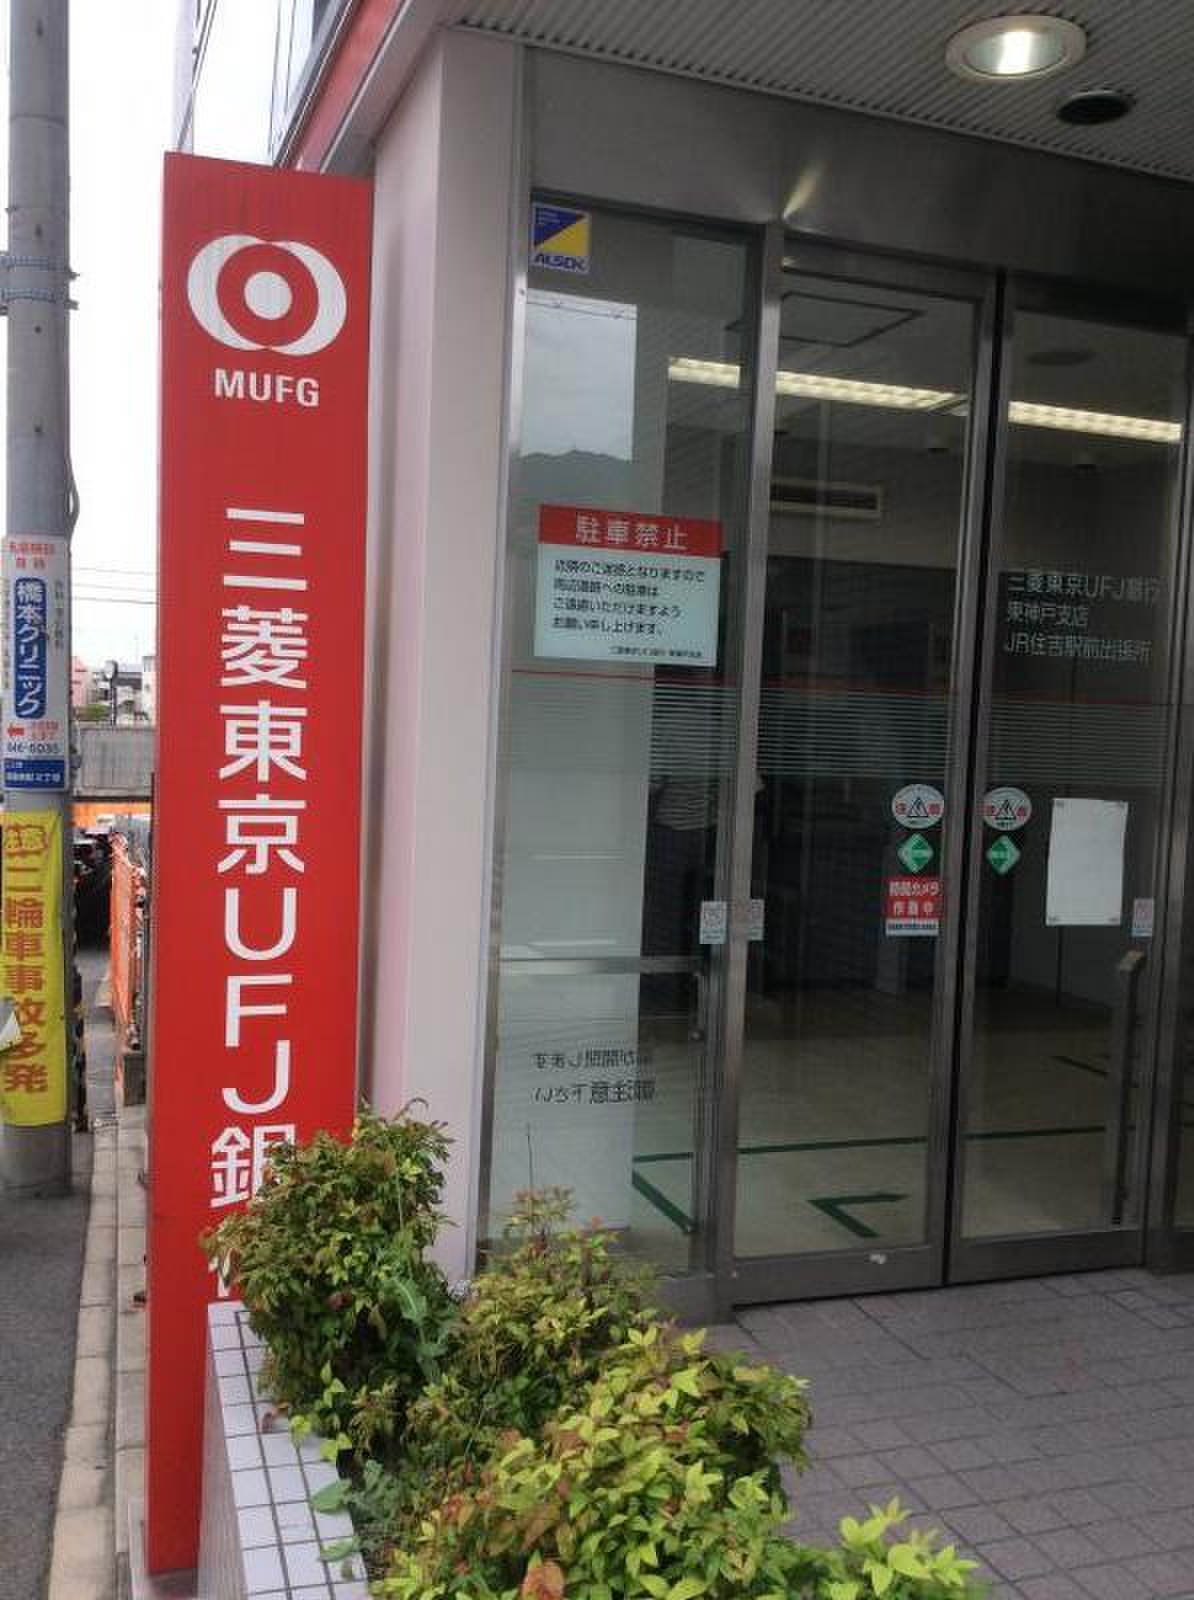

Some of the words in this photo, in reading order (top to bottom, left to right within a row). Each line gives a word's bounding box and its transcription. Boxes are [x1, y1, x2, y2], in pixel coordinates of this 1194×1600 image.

[214, 367, 320, 407] MUFG
[575, 514, 689, 550] 駐車禁止
[209, 507, 308, 1299] 三菱東京UFJ銀
